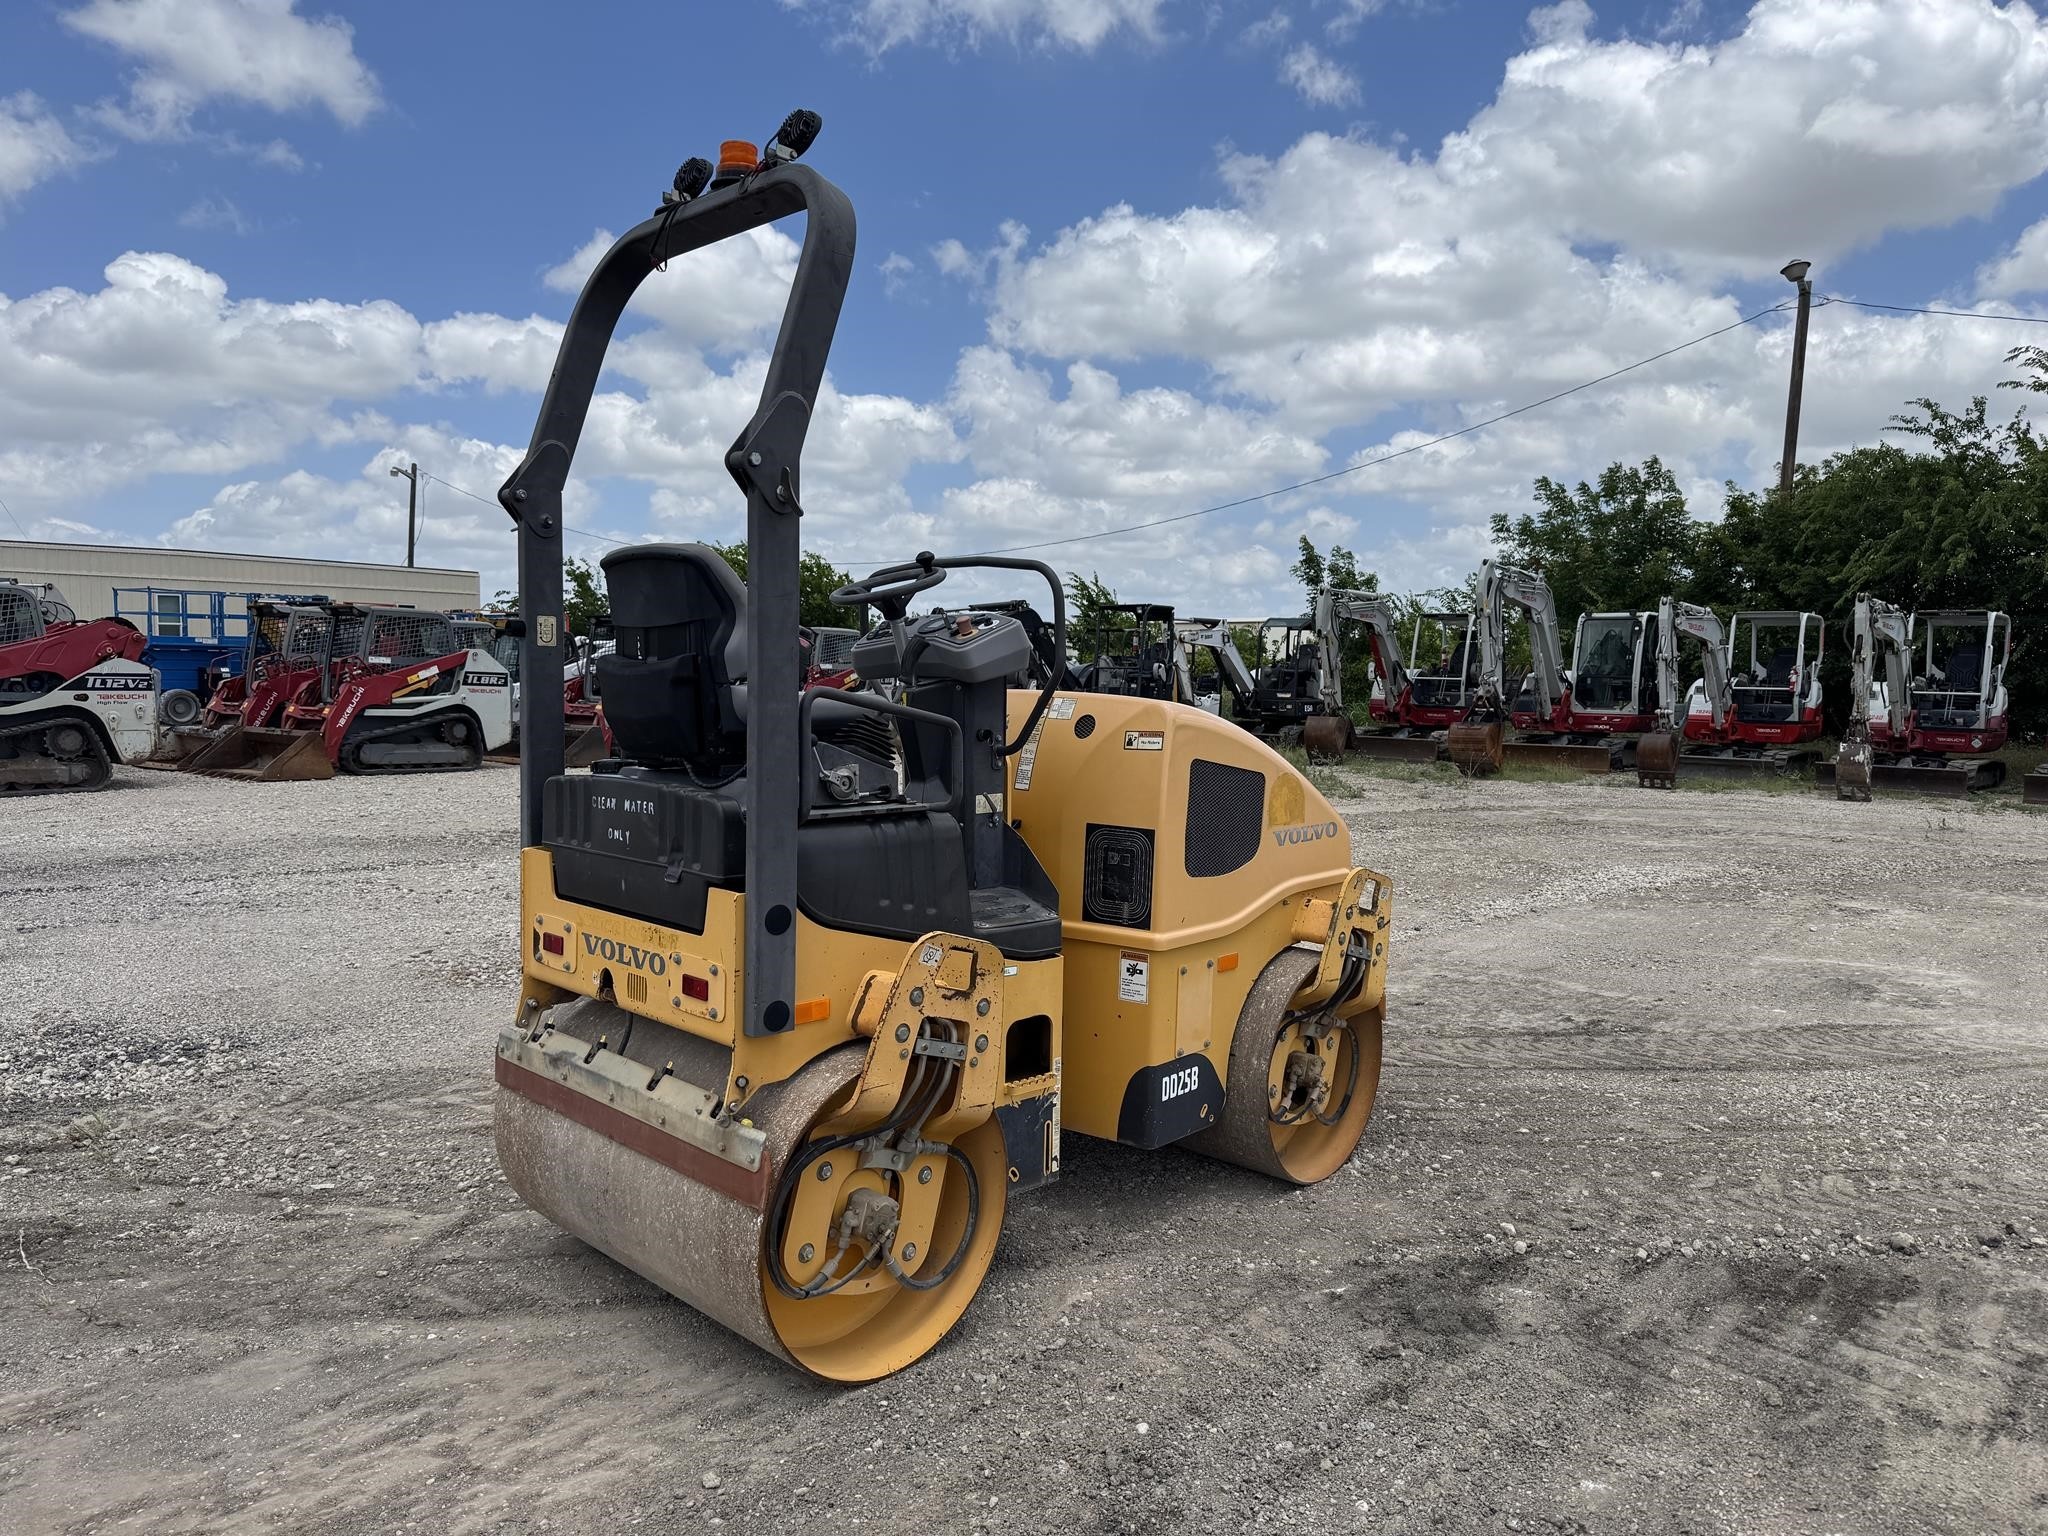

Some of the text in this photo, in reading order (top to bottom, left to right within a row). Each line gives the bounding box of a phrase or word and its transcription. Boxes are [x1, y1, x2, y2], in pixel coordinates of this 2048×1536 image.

[85, 676, 151, 689] TL12V2
[466, 673, 506, 685] TL8R2
[467, 687, 502, 695] TAKEUCHI
[336, 686, 365, 728] TAKEUCHI
[608, 827, 630, 845] ONLY
[1273, 821, 1339, 847] VOLVO
[581, 932, 666, 976] VOLVO
[1161, 1066, 1199, 1103] DD25B
